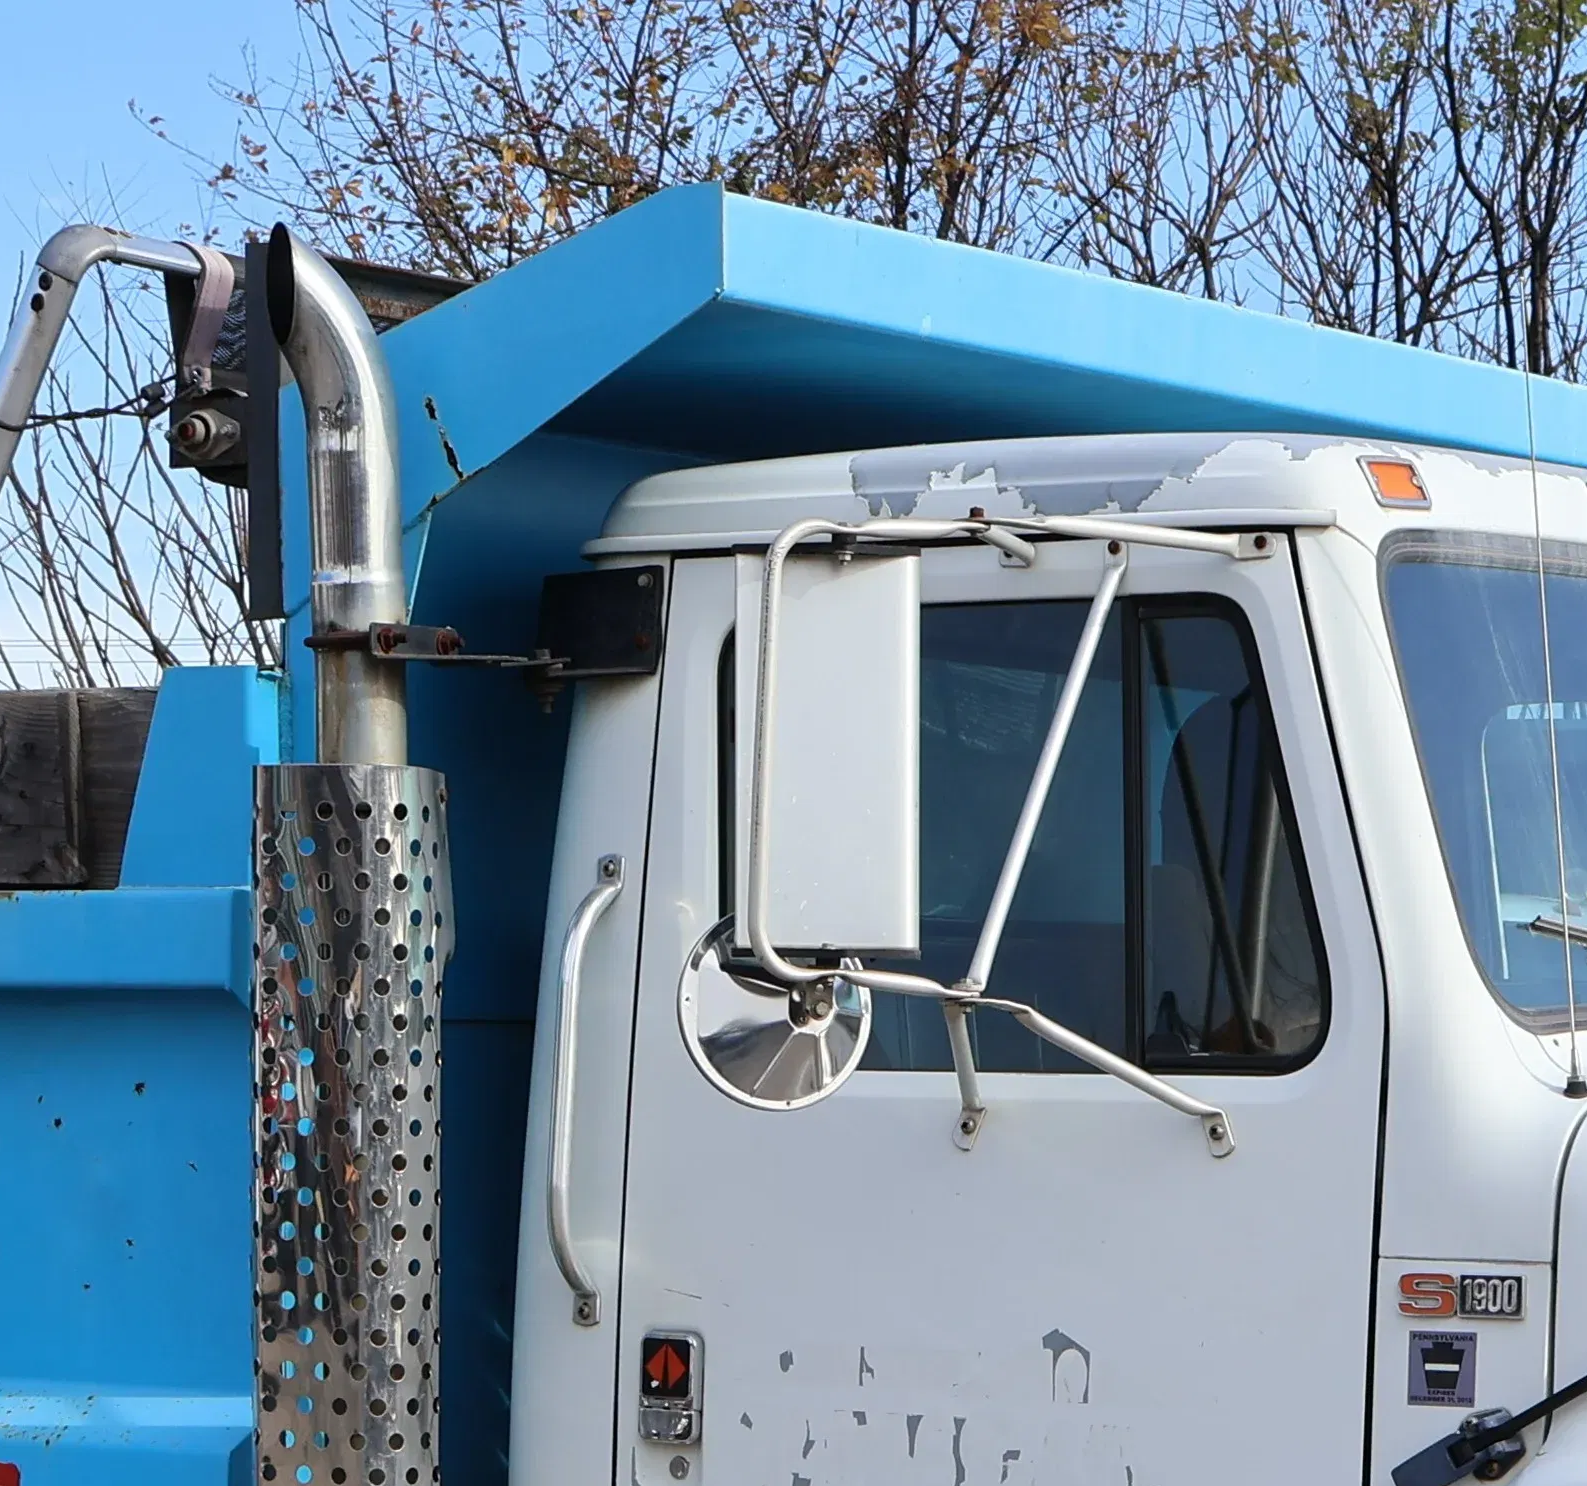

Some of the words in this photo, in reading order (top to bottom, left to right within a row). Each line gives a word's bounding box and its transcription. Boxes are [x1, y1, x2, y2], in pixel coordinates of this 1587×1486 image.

[1398, 1273, 1456, 1317] S
[1463, 1278, 1519, 1314] 1900
[1412, 1333, 1474, 1342] PENNSYLVANIA
